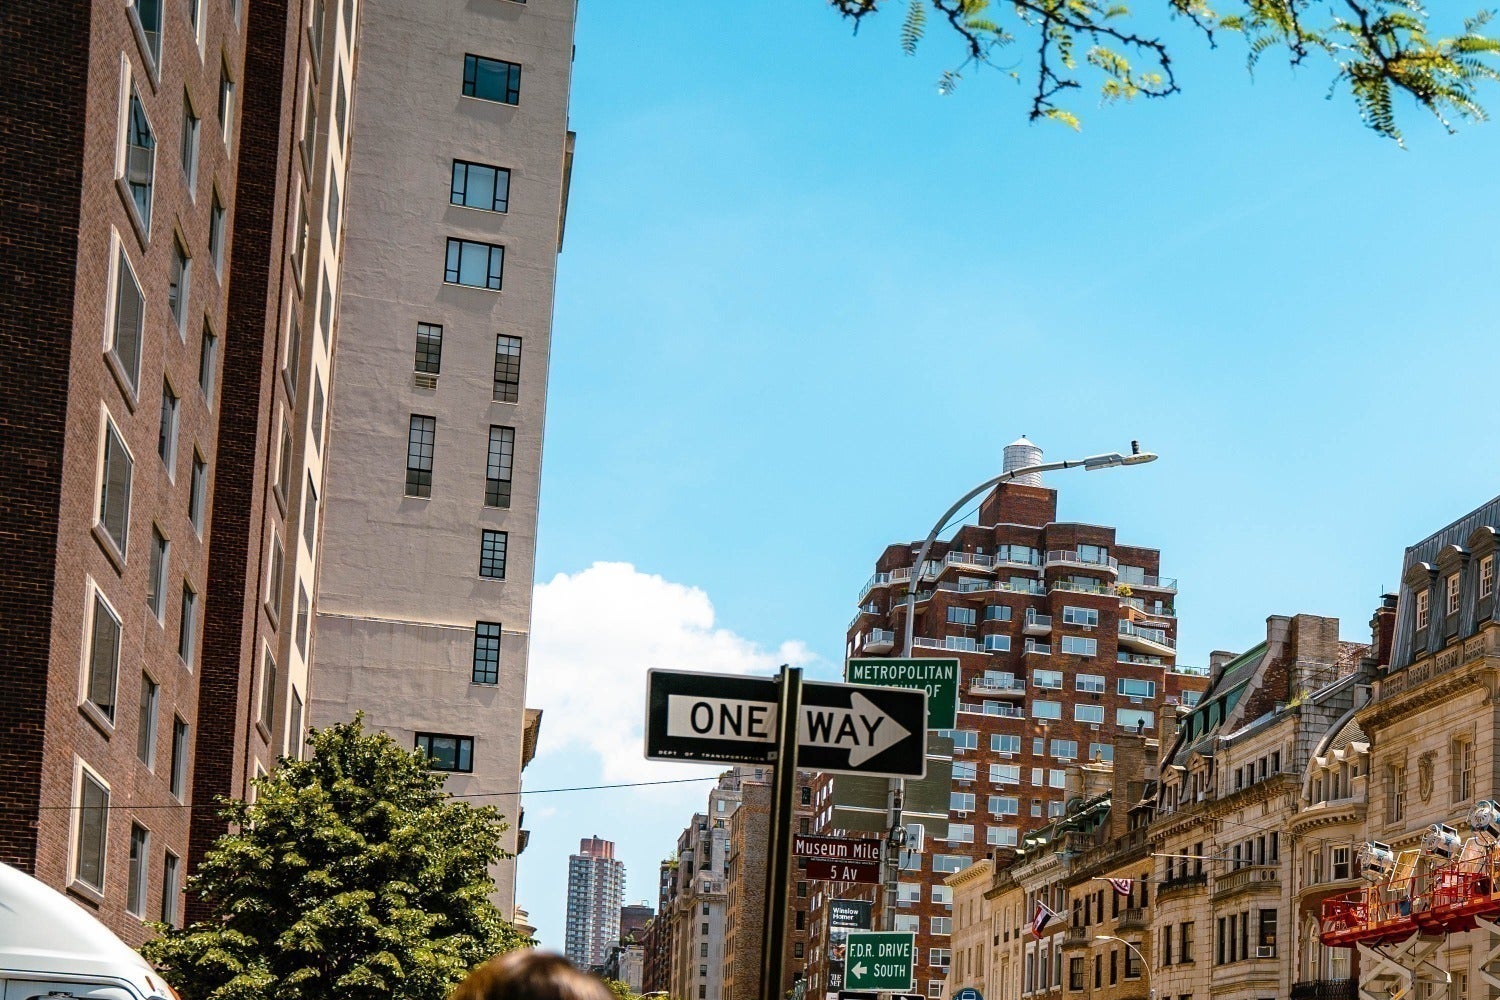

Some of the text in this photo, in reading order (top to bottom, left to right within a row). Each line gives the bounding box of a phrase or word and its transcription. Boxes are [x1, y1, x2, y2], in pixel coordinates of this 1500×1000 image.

[853, 665, 953, 680] METROPOLITAN
[925, 684, 942, 698] OF
[690, 701, 885, 747] ONE WAY
[795, 839, 879, 859] Museum Mile
[830, 865, 858, 880] 5 Av
[849, 943, 910, 957] F.D.R. DRIVE
[873, 963, 906, 977] SOUTH
